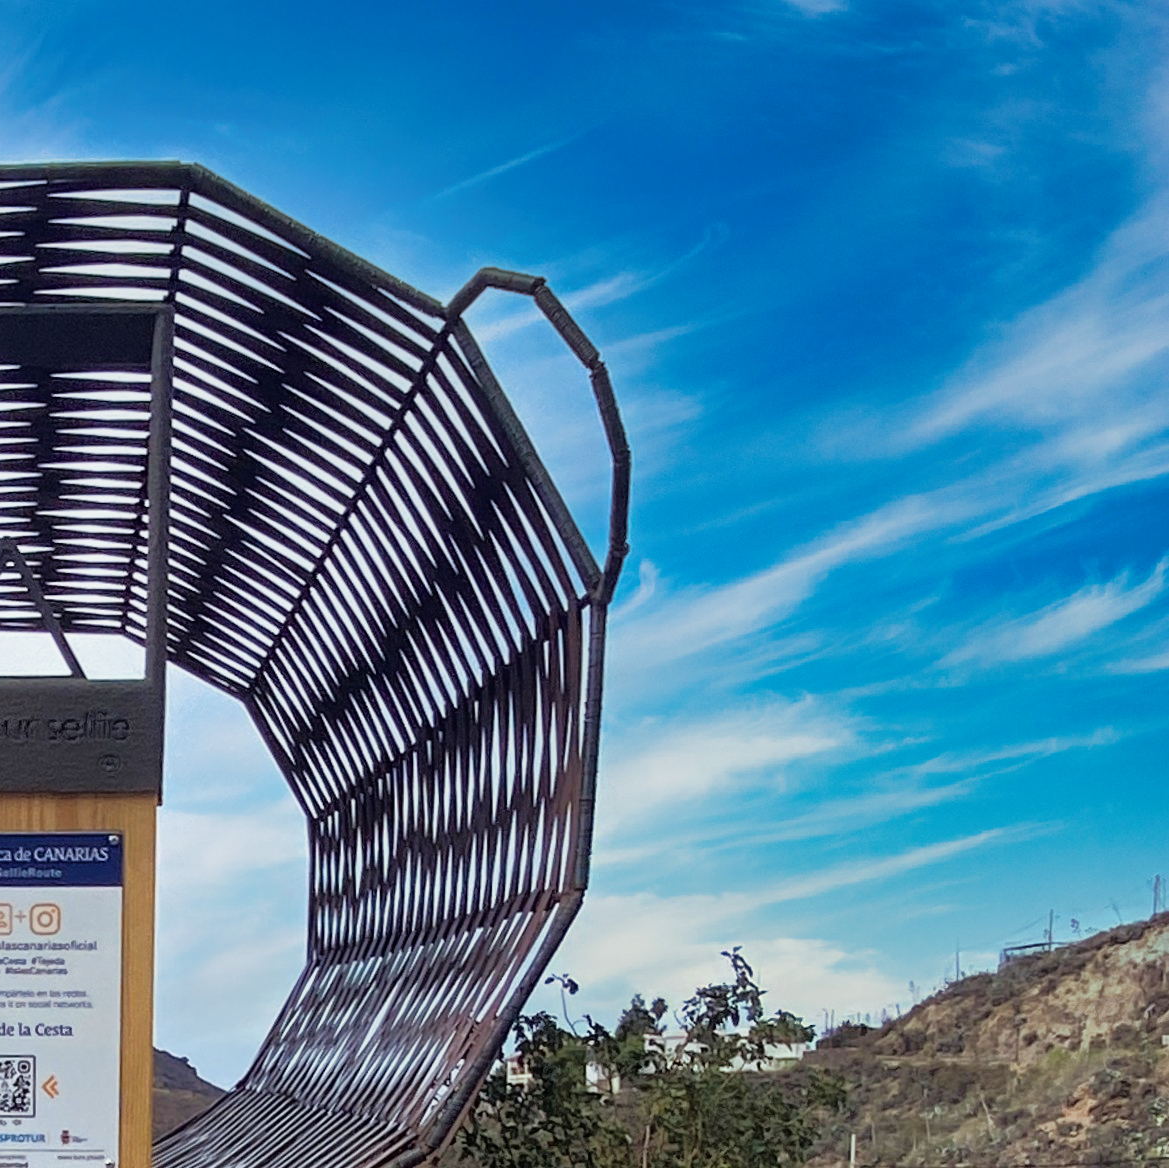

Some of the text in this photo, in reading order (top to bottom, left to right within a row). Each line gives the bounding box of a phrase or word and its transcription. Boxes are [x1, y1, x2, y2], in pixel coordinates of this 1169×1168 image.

[47, 711, 130, 740] selfie
[14, 846, 31, 861] de
[34, 847, 109, 861] CANARIAS
[18, 1022, 31, 1037] la
[34, 1023, 73, 1037] Cesta
